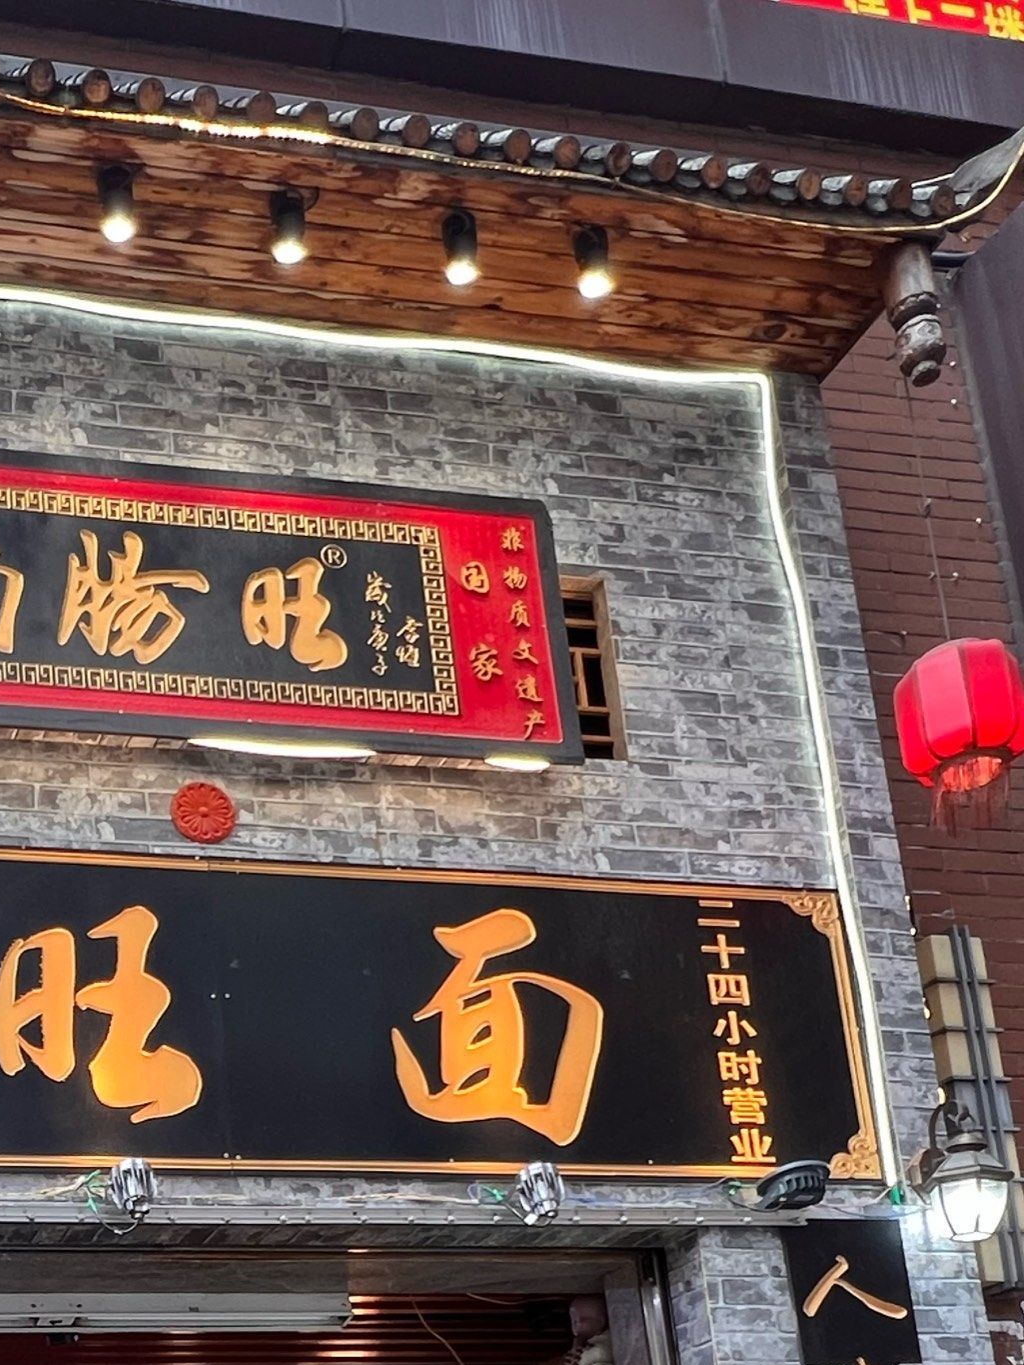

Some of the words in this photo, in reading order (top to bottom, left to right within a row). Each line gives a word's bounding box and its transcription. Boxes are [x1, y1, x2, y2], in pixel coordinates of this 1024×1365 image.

[460, 560, 504, 682] 国家
[499, 526, 547, 741] 非物质文遗产
[696, 899, 777, 1164] 二十四小时营业
